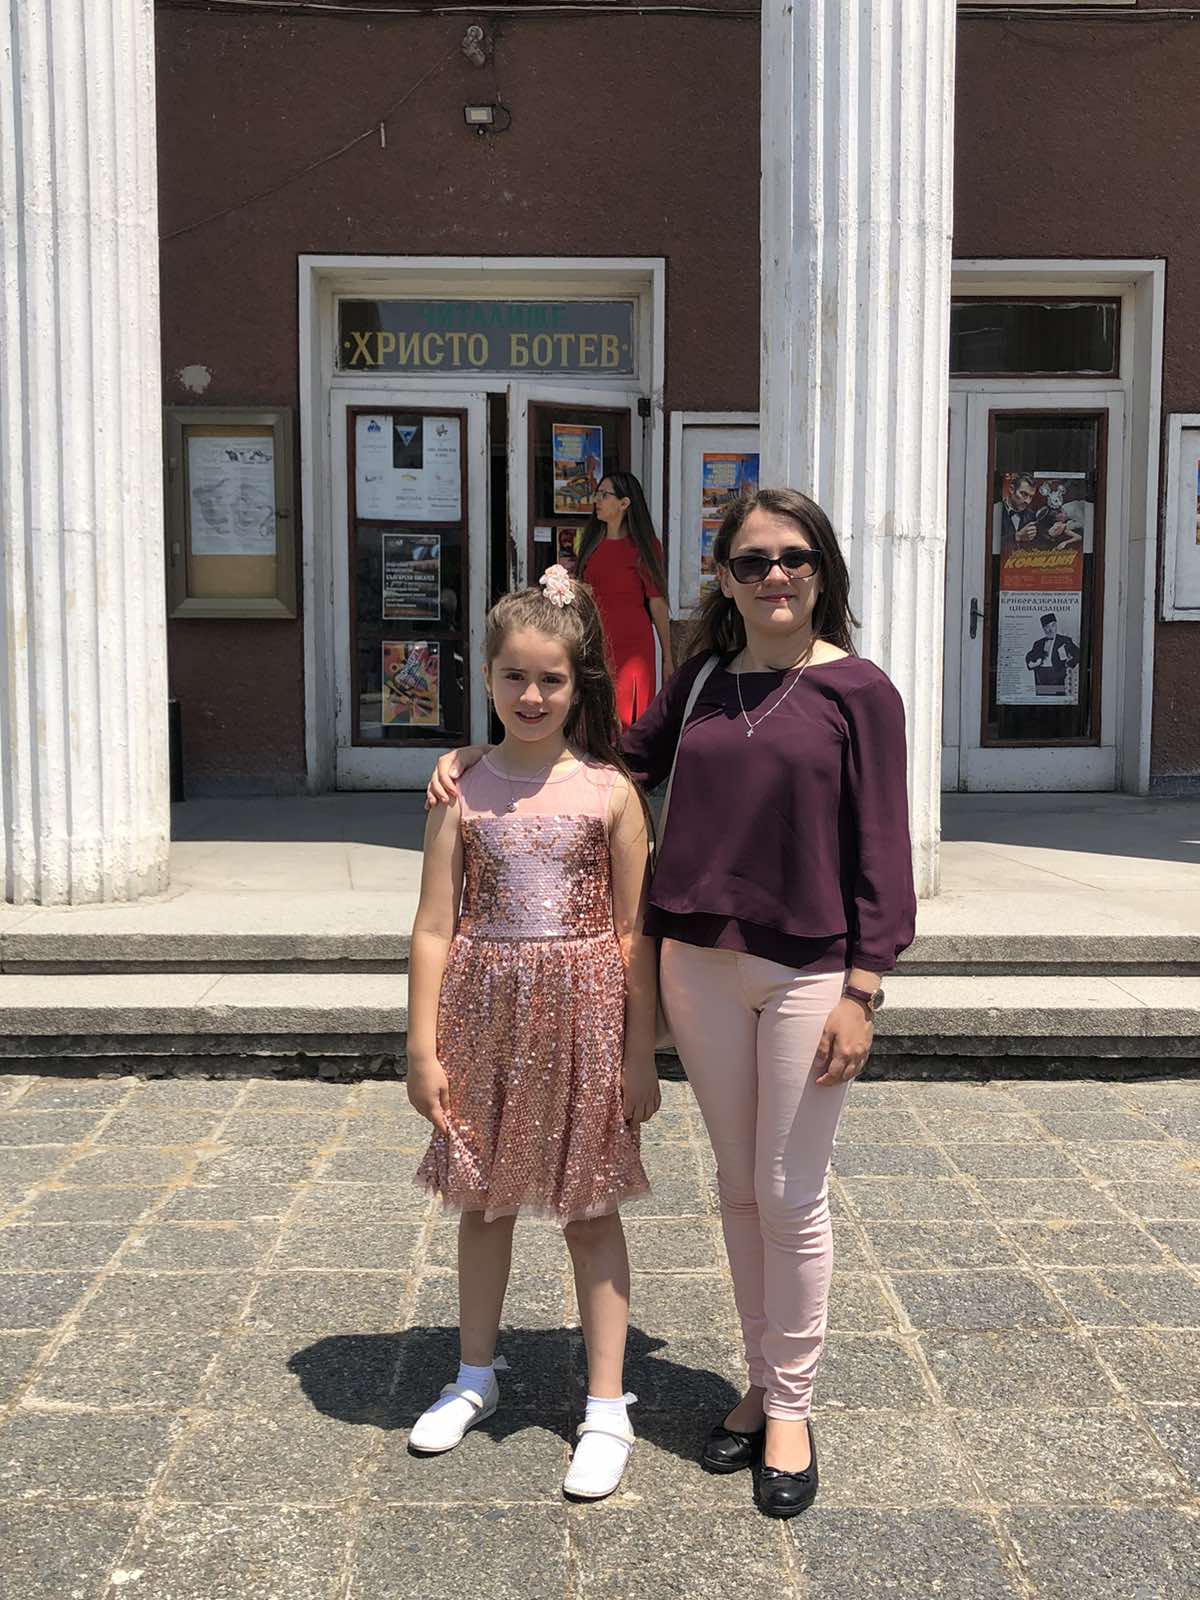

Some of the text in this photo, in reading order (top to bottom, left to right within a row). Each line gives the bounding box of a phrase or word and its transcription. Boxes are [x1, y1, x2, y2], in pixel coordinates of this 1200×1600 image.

[423, 304, 567, 328] ЧИТАЛИЩЕ
[350, 331, 621, 367] ХРИСТО БОТЕВ
